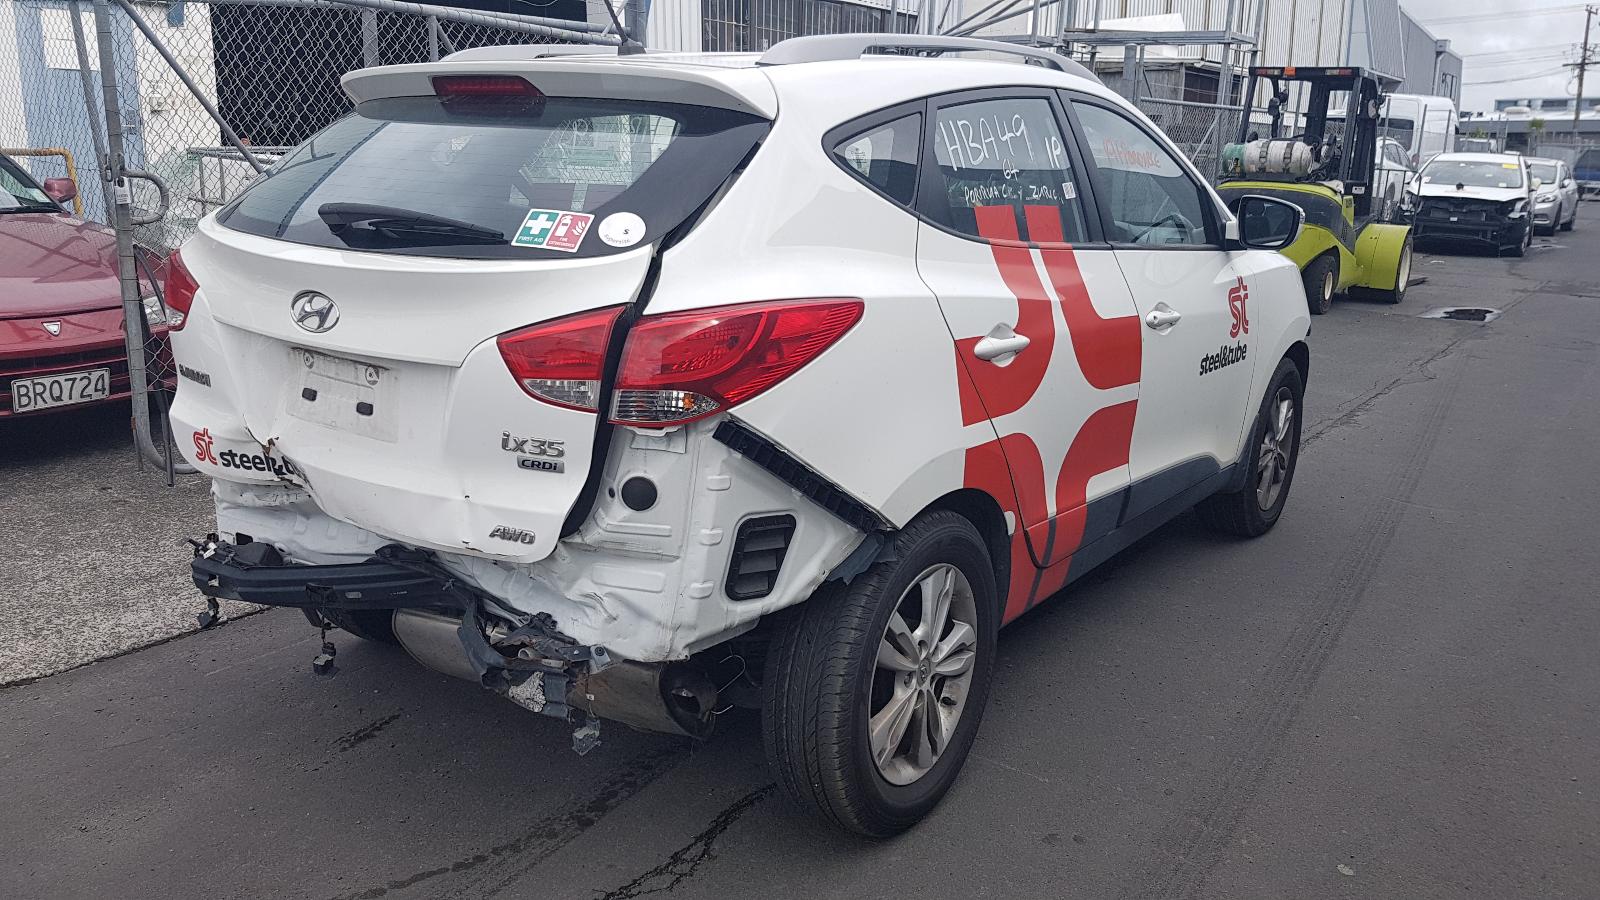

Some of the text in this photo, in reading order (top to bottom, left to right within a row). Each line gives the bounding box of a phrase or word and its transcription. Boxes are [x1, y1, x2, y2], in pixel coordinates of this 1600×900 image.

[1200, 340, 1247, 376] steel&tube
[16, 373, 107, 408] BRQ724
[501, 430, 565, 458] ix35
[521, 459, 558, 471] CRDi
[489, 525, 536, 545] AWD
